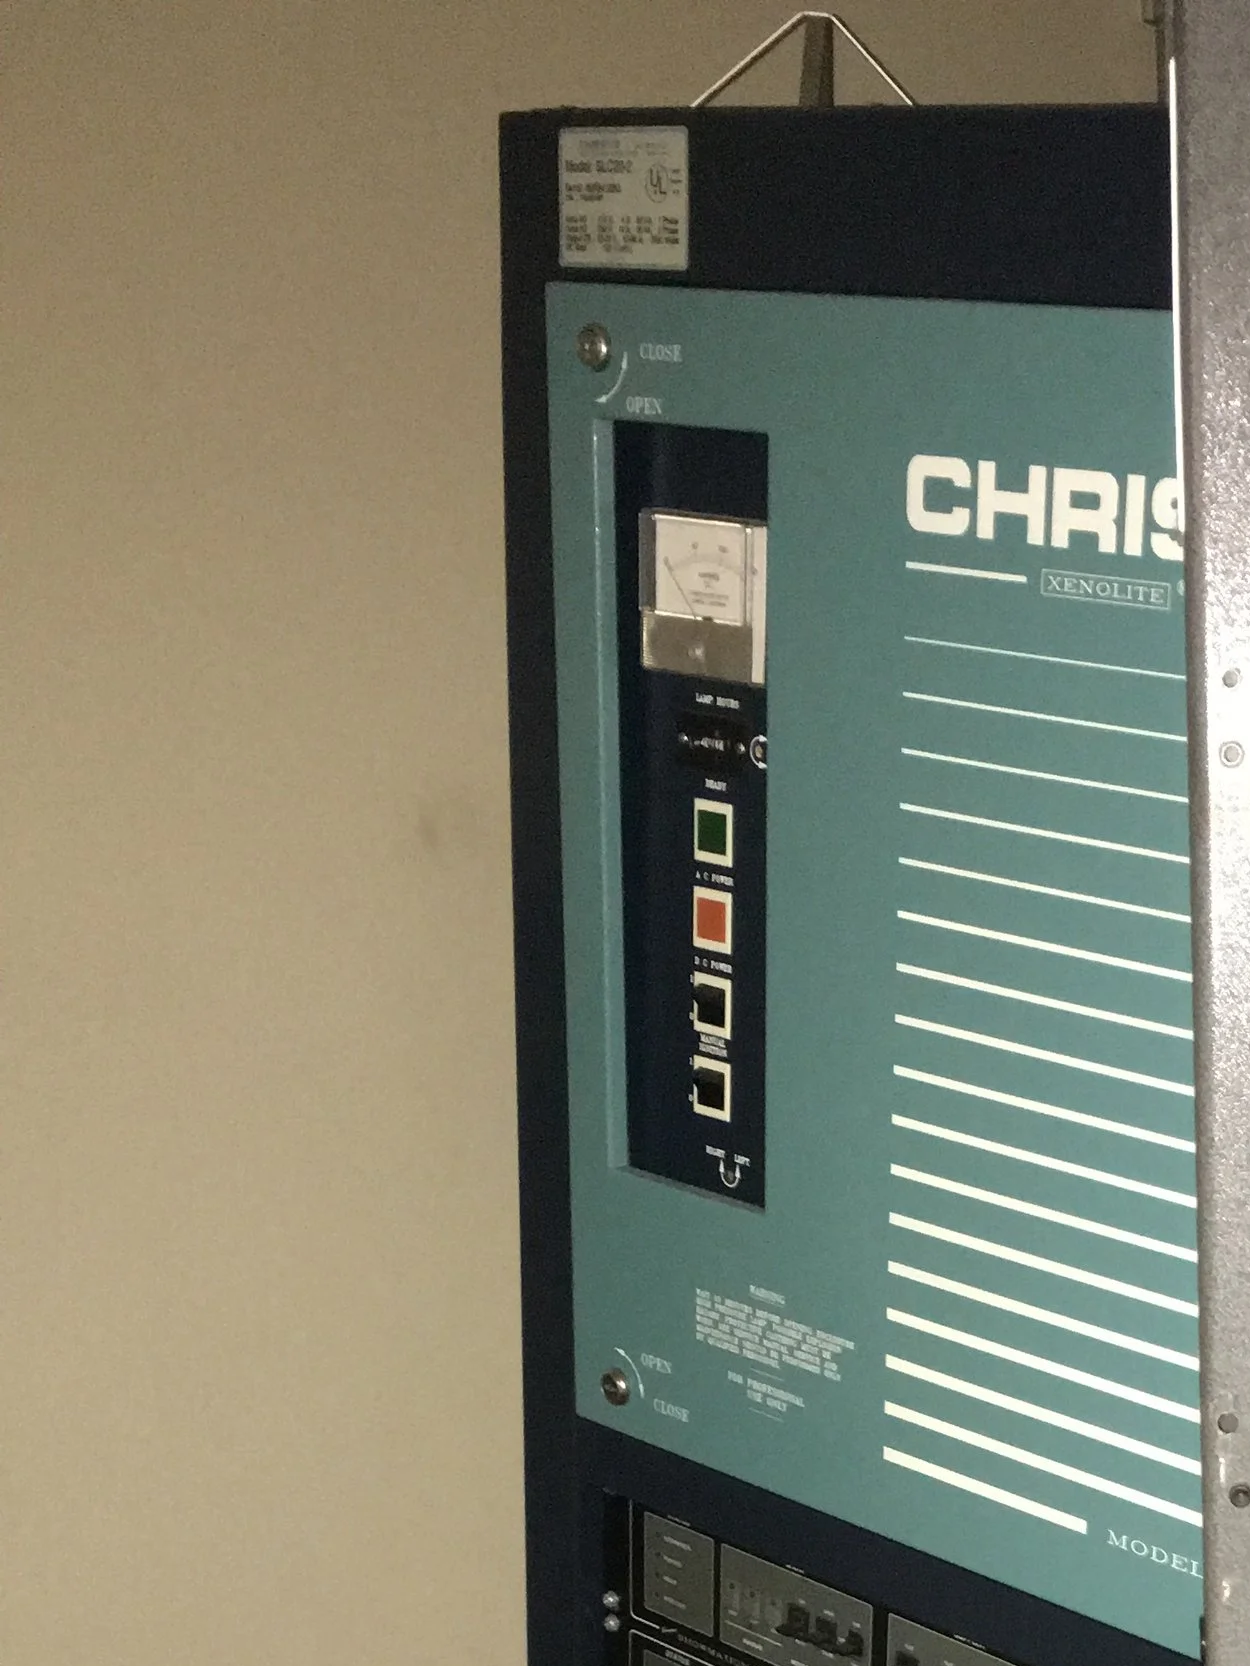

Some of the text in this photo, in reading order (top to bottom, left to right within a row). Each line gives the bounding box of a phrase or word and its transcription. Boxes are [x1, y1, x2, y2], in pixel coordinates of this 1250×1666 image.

[640, 342, 683, 363] CLOSE
[626, 396, 662, 415] OPEN
[1047, 574, 1165, 605] XENOLITE
[640, 1352, 672, 1374] OPEN
[653, 1398, 690, 1423] CLOSE
[1106, 1527, 1204, 1580] MODEL
